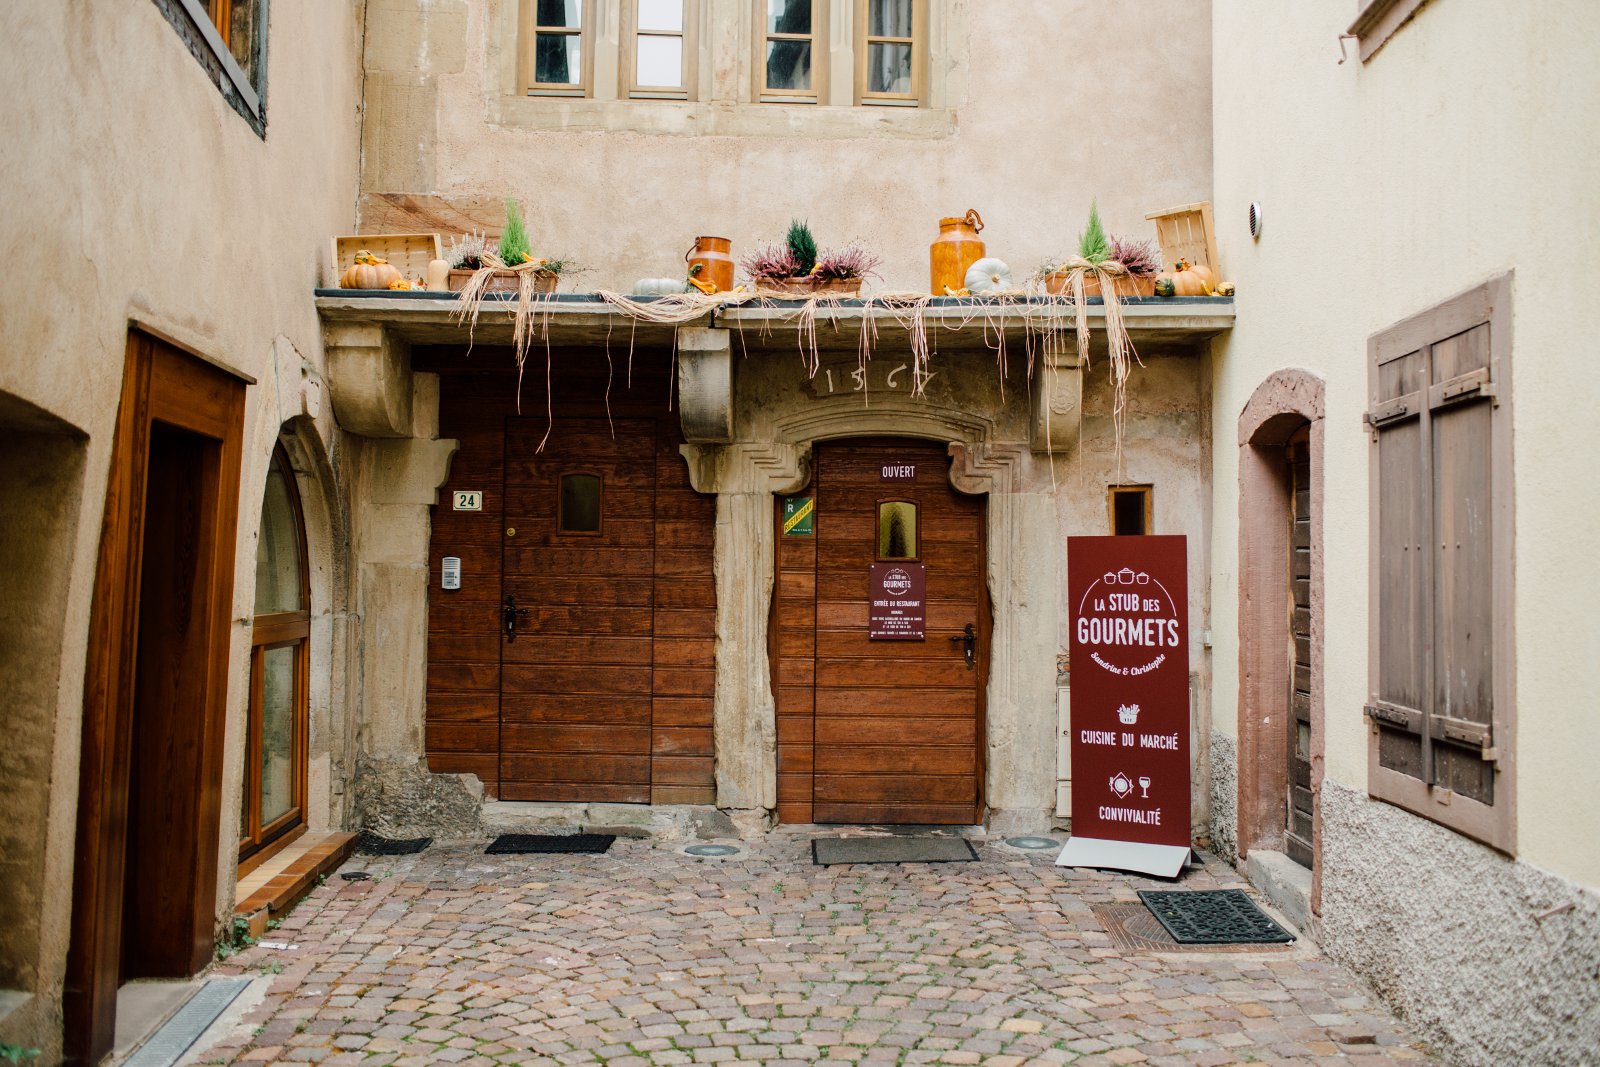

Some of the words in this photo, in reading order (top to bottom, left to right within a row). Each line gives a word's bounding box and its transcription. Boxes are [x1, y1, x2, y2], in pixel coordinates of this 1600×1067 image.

[882, 465, 916, 478] OUVERT
[460, 495, 475, 507] 24
[787, 503, 794, 513] R
[883, 580, 911, 589] GOURMETS
[873, 599, 889, 607] ENTRÉE
[1094, 598, 1106, 612] LA
[1109, 593, 1140, 612] STUB
[1142, 599, 1160, 612] DES
[1077, 617, 1179, 647] GOURMETS
[1090, 651, 1122, 675] Sandrine
[1122, 667, 1129, 676] &
[1130, 653, 1166, 676] Christophe
[1081, 730, 1117, 746] CUISINE
[1122, 733, 1134, 747] DU
[1140, 732, 1179, 751] MARCHÉ
[1099, 805, 1161, 826] CONVIVIALITÉ
